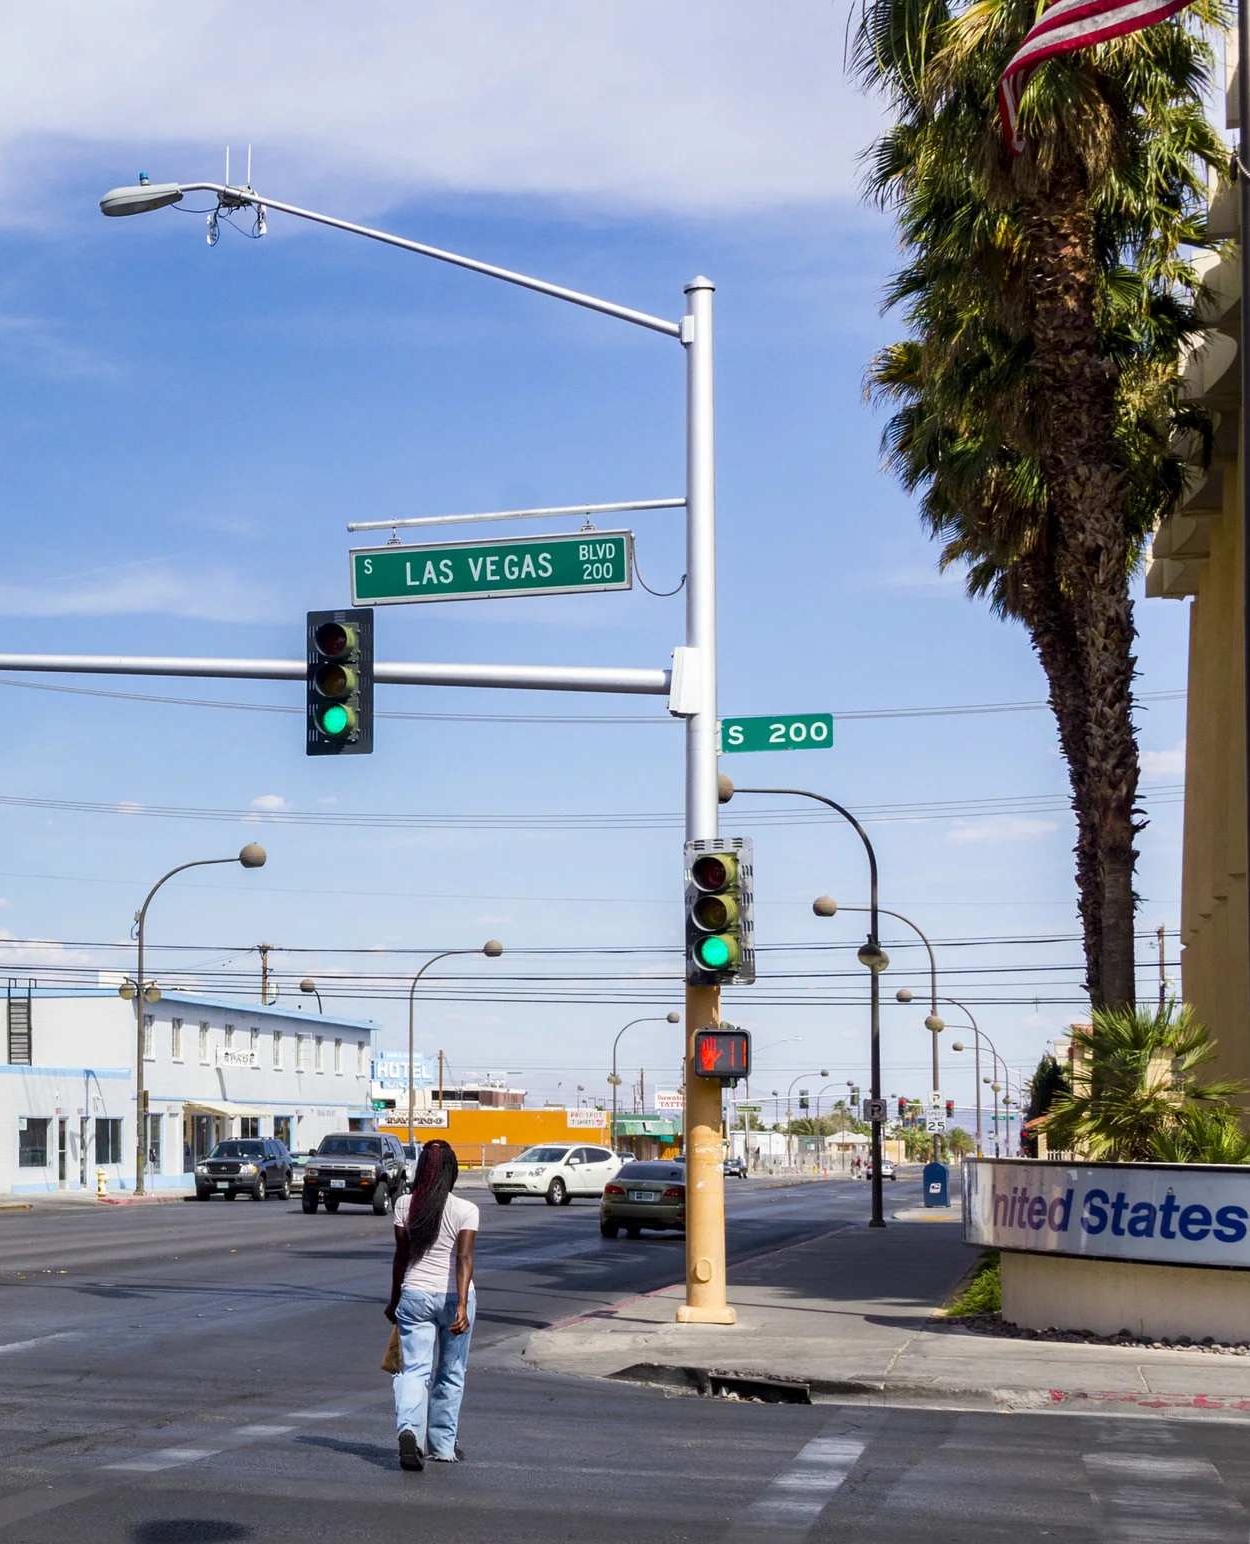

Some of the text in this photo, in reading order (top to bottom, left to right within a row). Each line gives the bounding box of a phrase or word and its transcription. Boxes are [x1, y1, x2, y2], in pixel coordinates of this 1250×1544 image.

[363, 543, 616, 587] S LAS VEGAS BLVD
[582, 563, 614, 580] 200
[727, 721, 829, 745] S 200
[377, 1061, 432, 1079] HOTEL
[928, 1121, 945, 1131] 25
[982, 1184, 1249, 1244] United States
